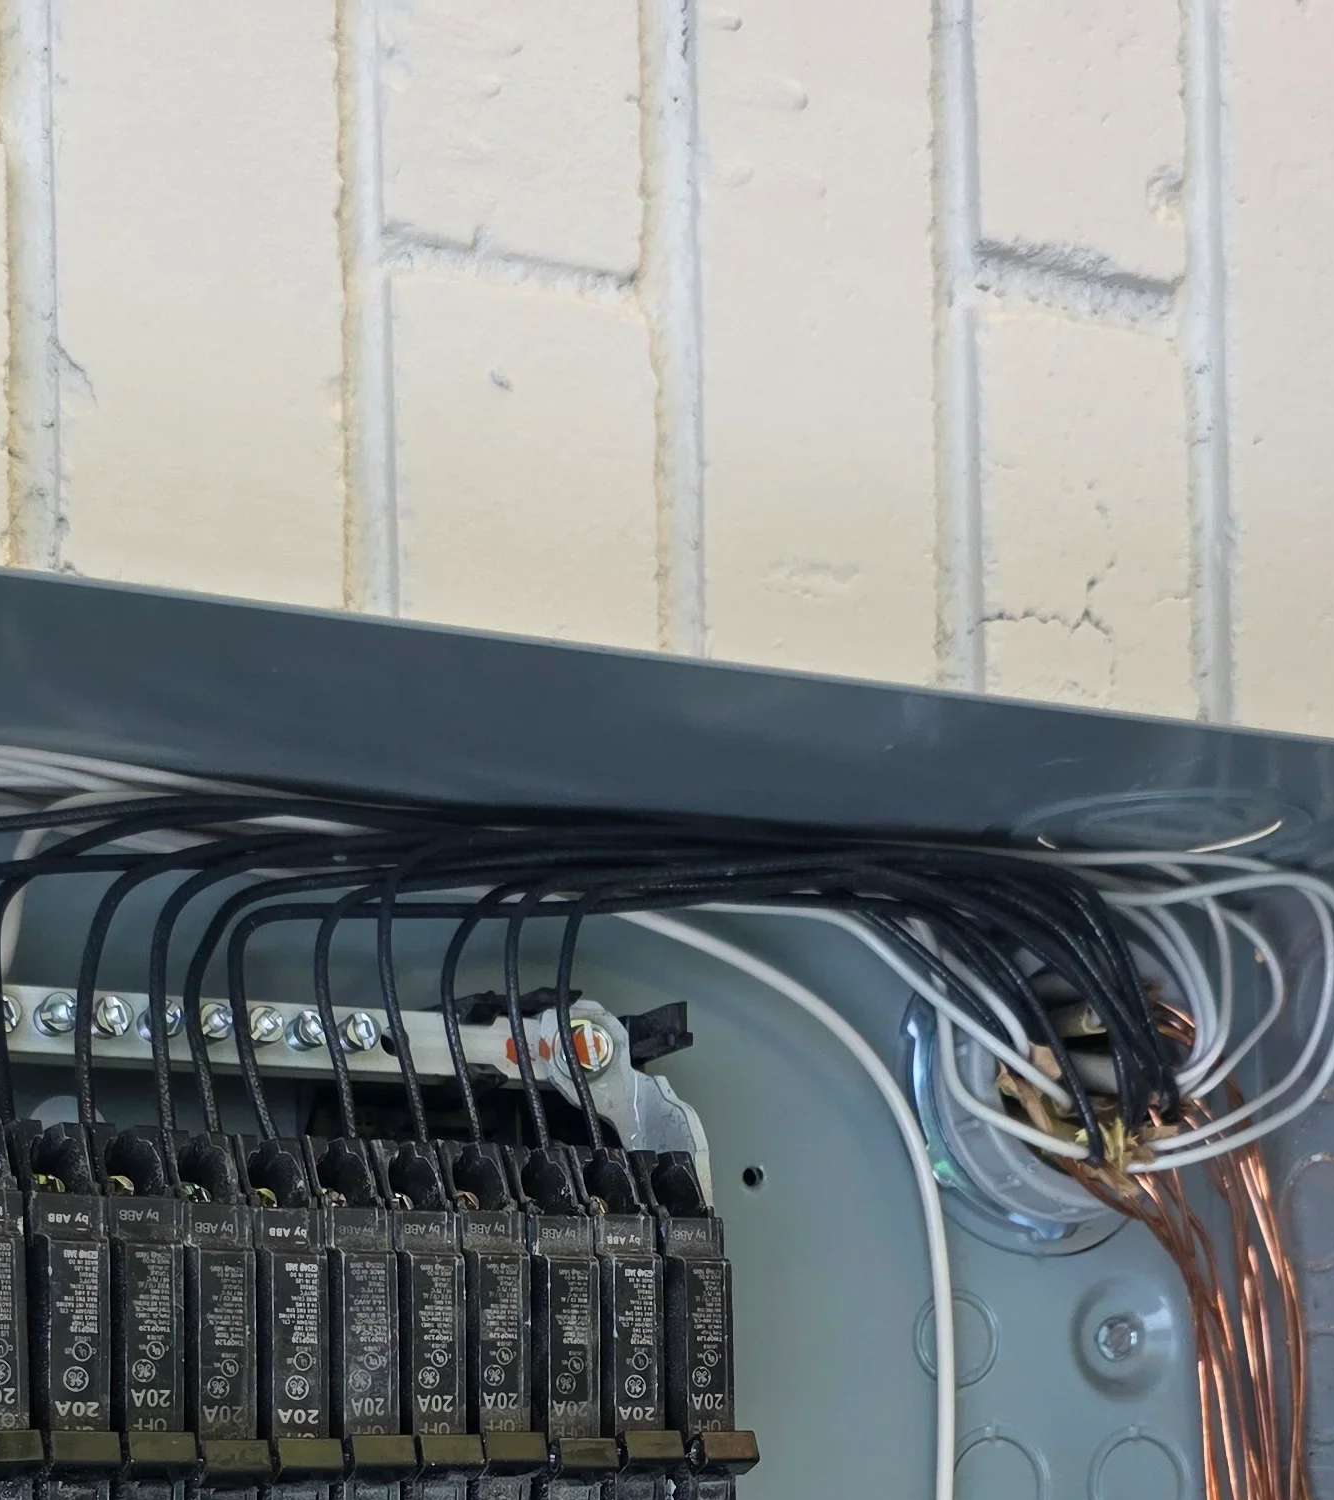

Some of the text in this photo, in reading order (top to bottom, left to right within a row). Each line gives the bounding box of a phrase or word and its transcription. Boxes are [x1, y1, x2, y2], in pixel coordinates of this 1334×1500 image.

[48, 1213, 88, 1224] by ABB
[119, 1209, 159, 1221] by ABB
[195, 1222, 233, 1233] by ABB
[269, 1227, 307, 1238] by ABB
[363, 1226, 374, 1235] by
[404, 1223, 440, 1234] by ABB
[469, 1223, 505, 1233] by ABB
[542, 1228, 575, 1239] by ABB
[607, 1235, 640, 1245] by ABB
[674, 1229, 706, 1241] by ABB
[131, 1389, 171, 1407] 20A
[417, 1395, 453, 1412] 20A
[483, 1392, 517, 1409] 20A
[692, 1393, 723, 1410] 20A
[55, 1401, 99, 1417] 20A
[351, 1398, 384, 1416] 20A
[553, 1400, 588, 1416] 20A
[203, 1406, 243, 1423] 20A
[278, 1409, 319, 1424] 20A
[619, 1407, 654, 1420] 20A
